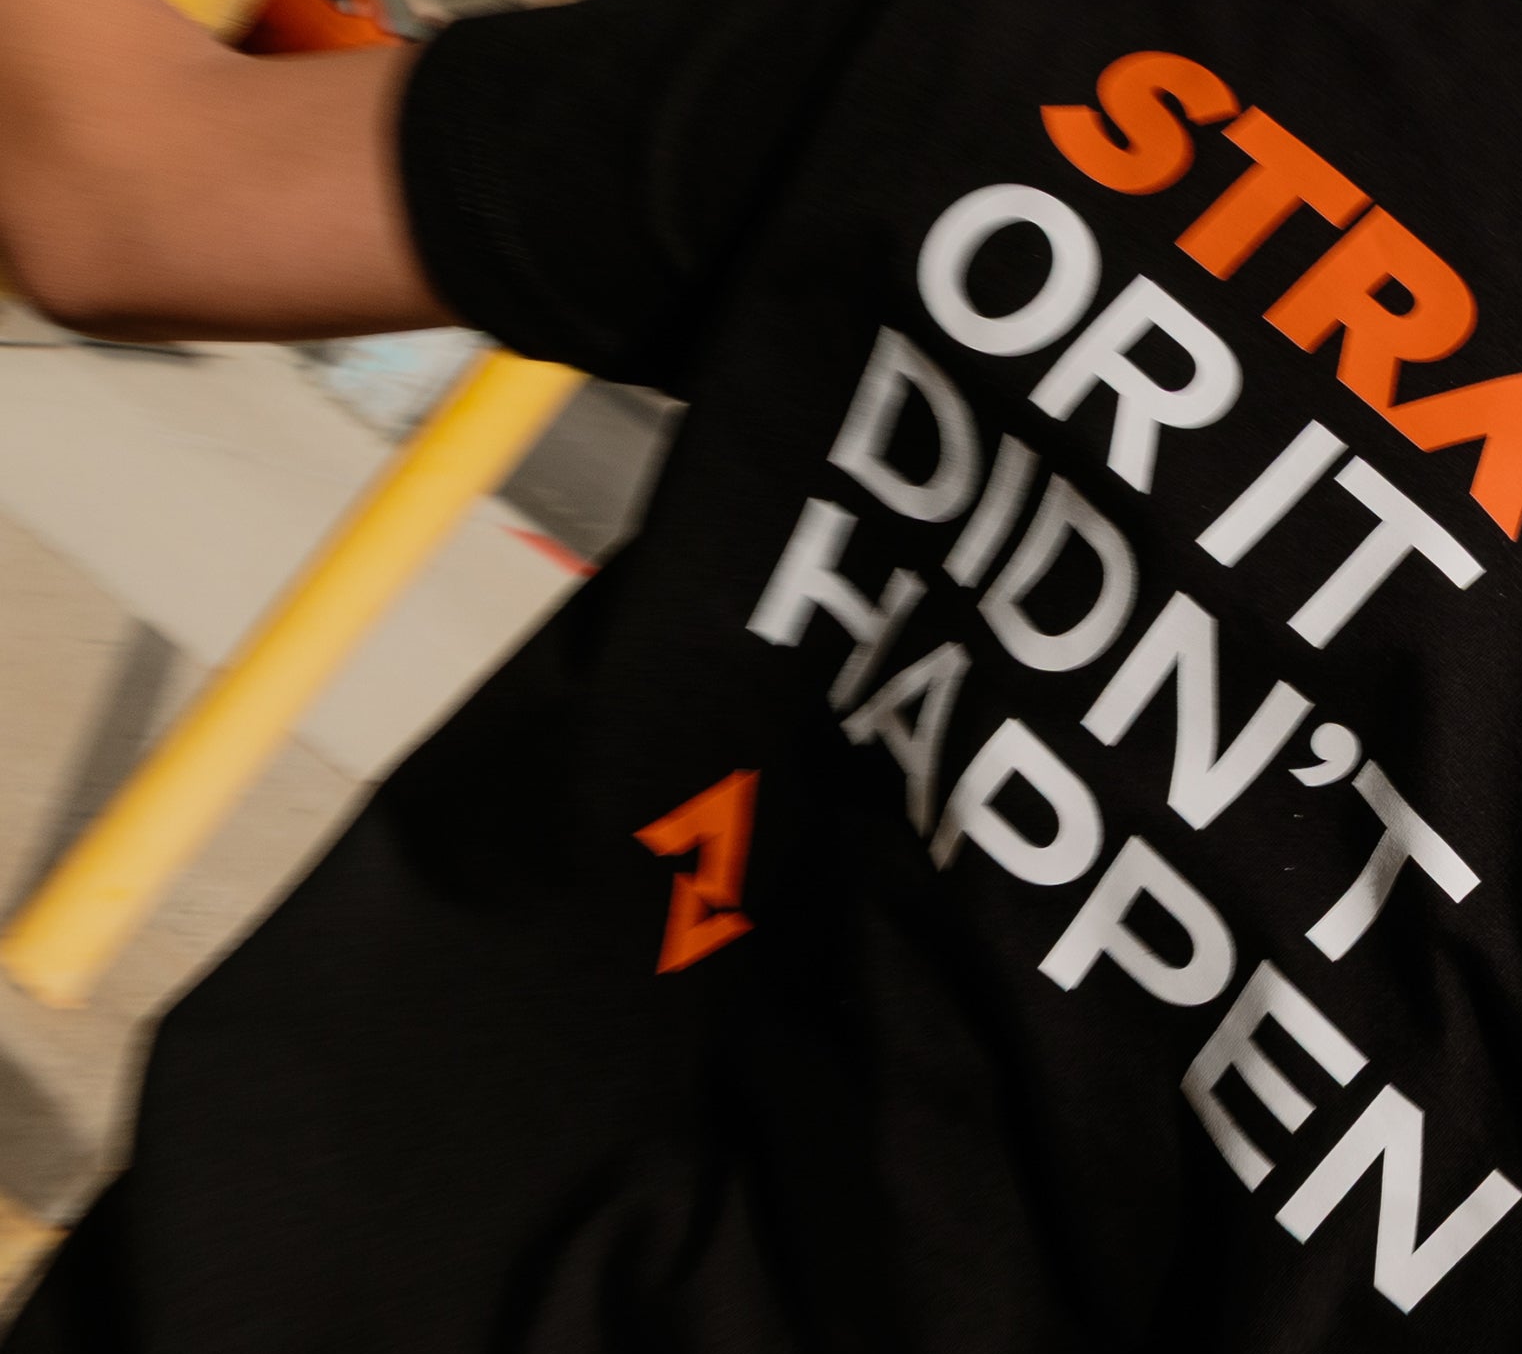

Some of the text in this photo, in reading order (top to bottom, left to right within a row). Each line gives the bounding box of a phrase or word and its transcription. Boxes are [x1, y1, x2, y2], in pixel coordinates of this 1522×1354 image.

[826, 324, 1482, 962] DIDN'T
[916, 183, 1486, 649] OR IT
